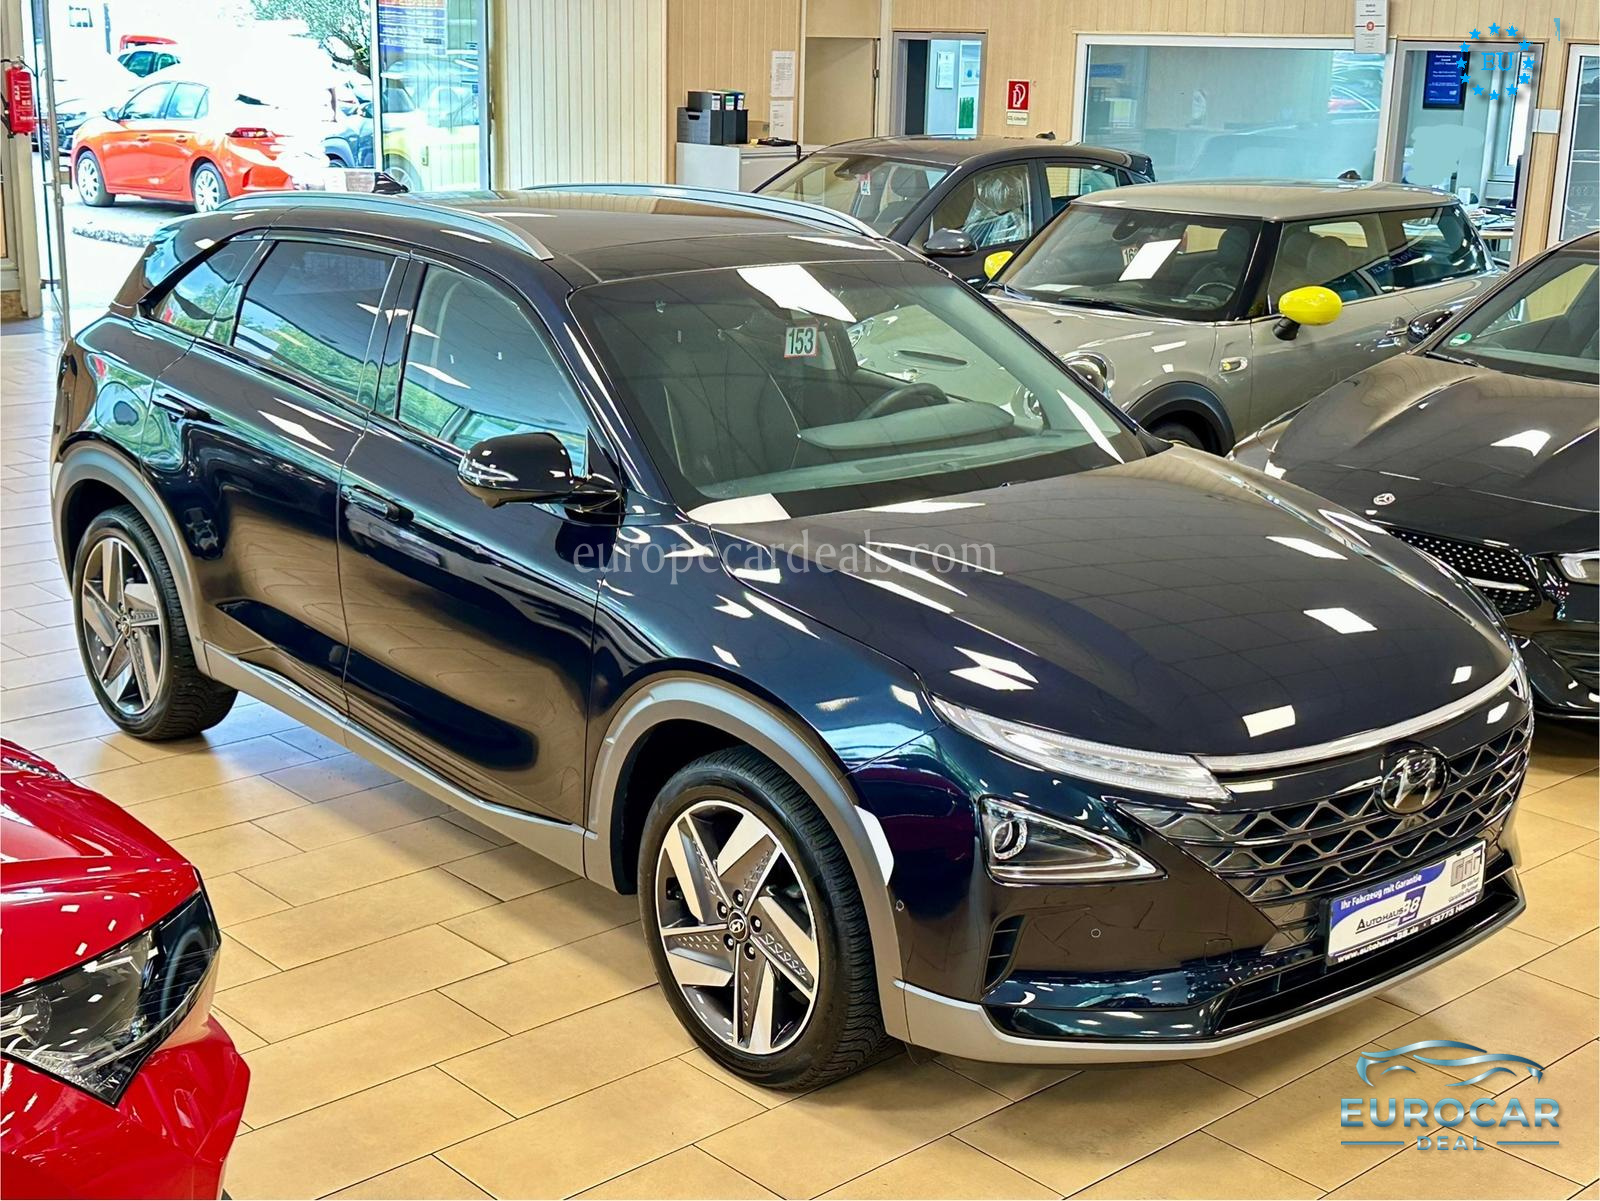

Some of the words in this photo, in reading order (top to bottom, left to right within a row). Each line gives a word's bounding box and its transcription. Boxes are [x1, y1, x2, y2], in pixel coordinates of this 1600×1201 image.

[789, 327, 814, 355] 153
[1340, 899, 1352, 911] Ihr
[1352, 889, 1383, 907] Fahrzeug
[1383, 883, 1395, 896] mit
[1395, 873, 1423, 890] Garantie
